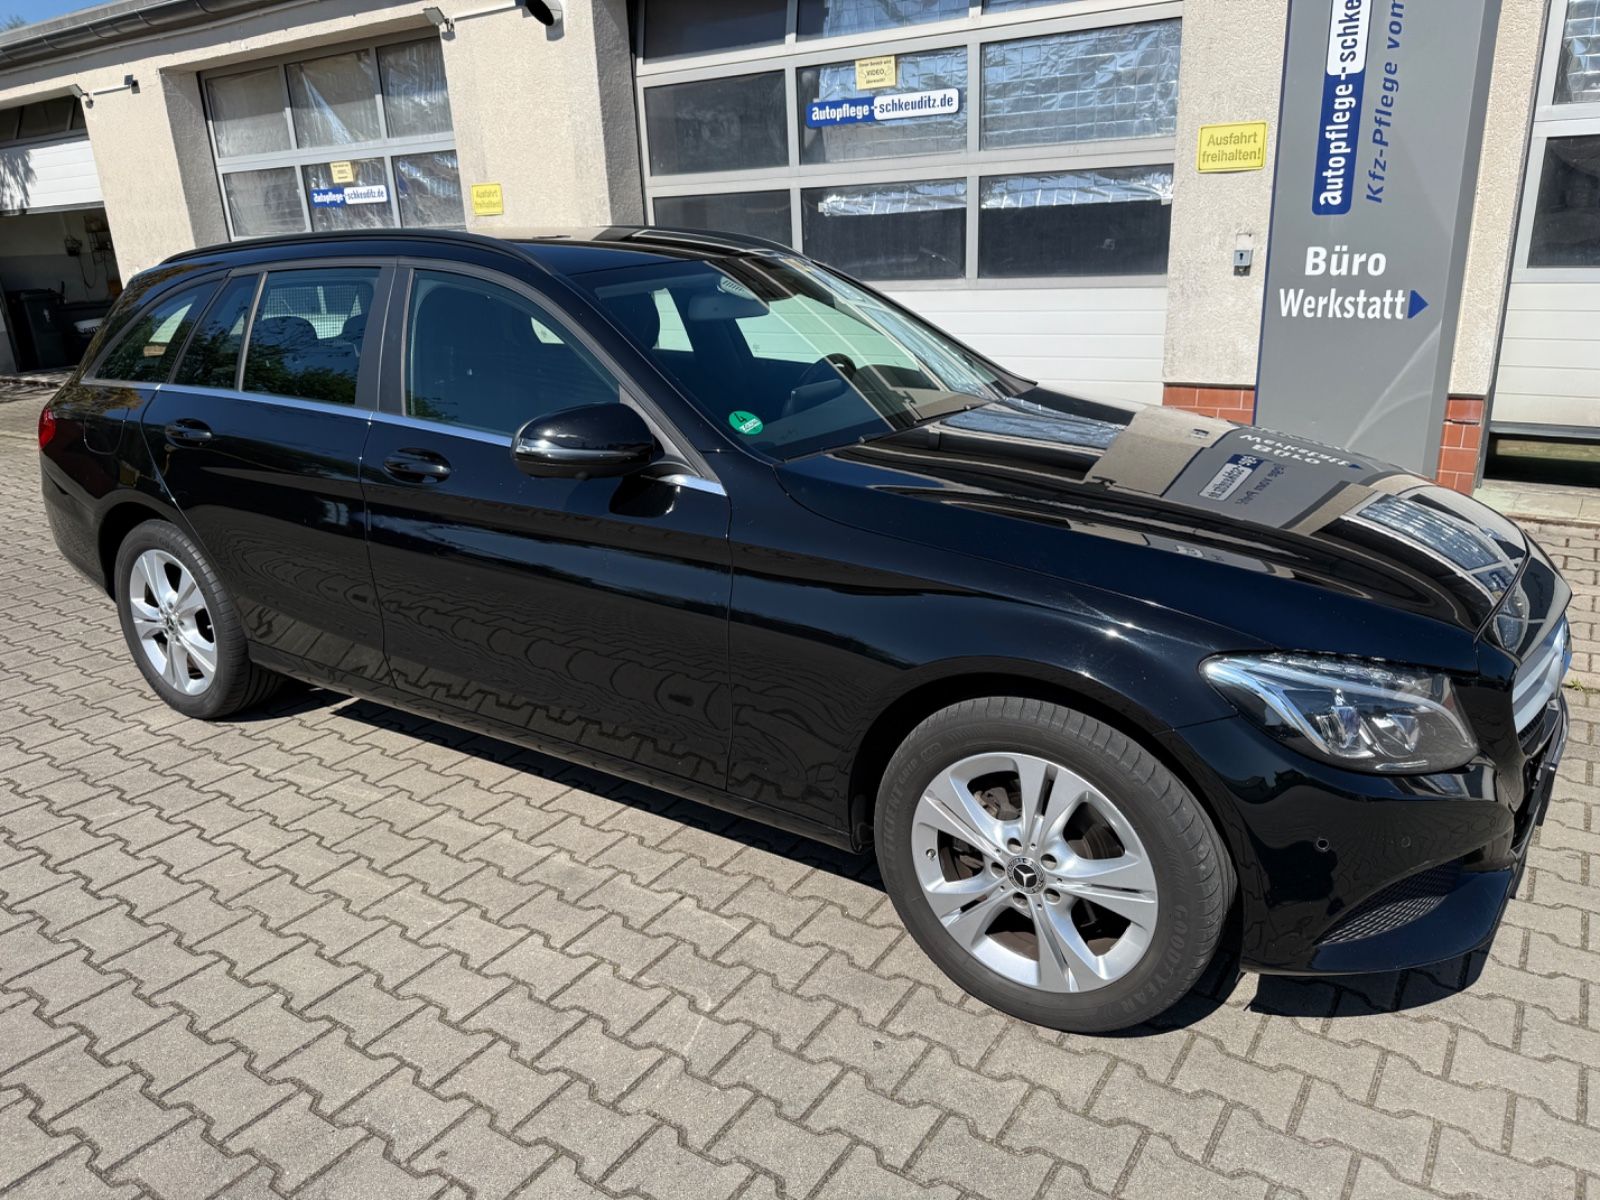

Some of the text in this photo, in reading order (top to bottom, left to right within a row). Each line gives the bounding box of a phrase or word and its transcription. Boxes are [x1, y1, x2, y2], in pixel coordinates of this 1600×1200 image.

[1207, 131, 1258, 147] Ausfahrt
[1366, 61, 1400, 204] Kfz-Pflege
[1201, 147, 1261, 163] freihalten!
[1304, 244, 1387, 277] Büro
[1279, 288, 1405, 320] Werkstatt
[733, 411, 748, 423] 4
[1120, 905, 1189, 1014] GOODYEAR
